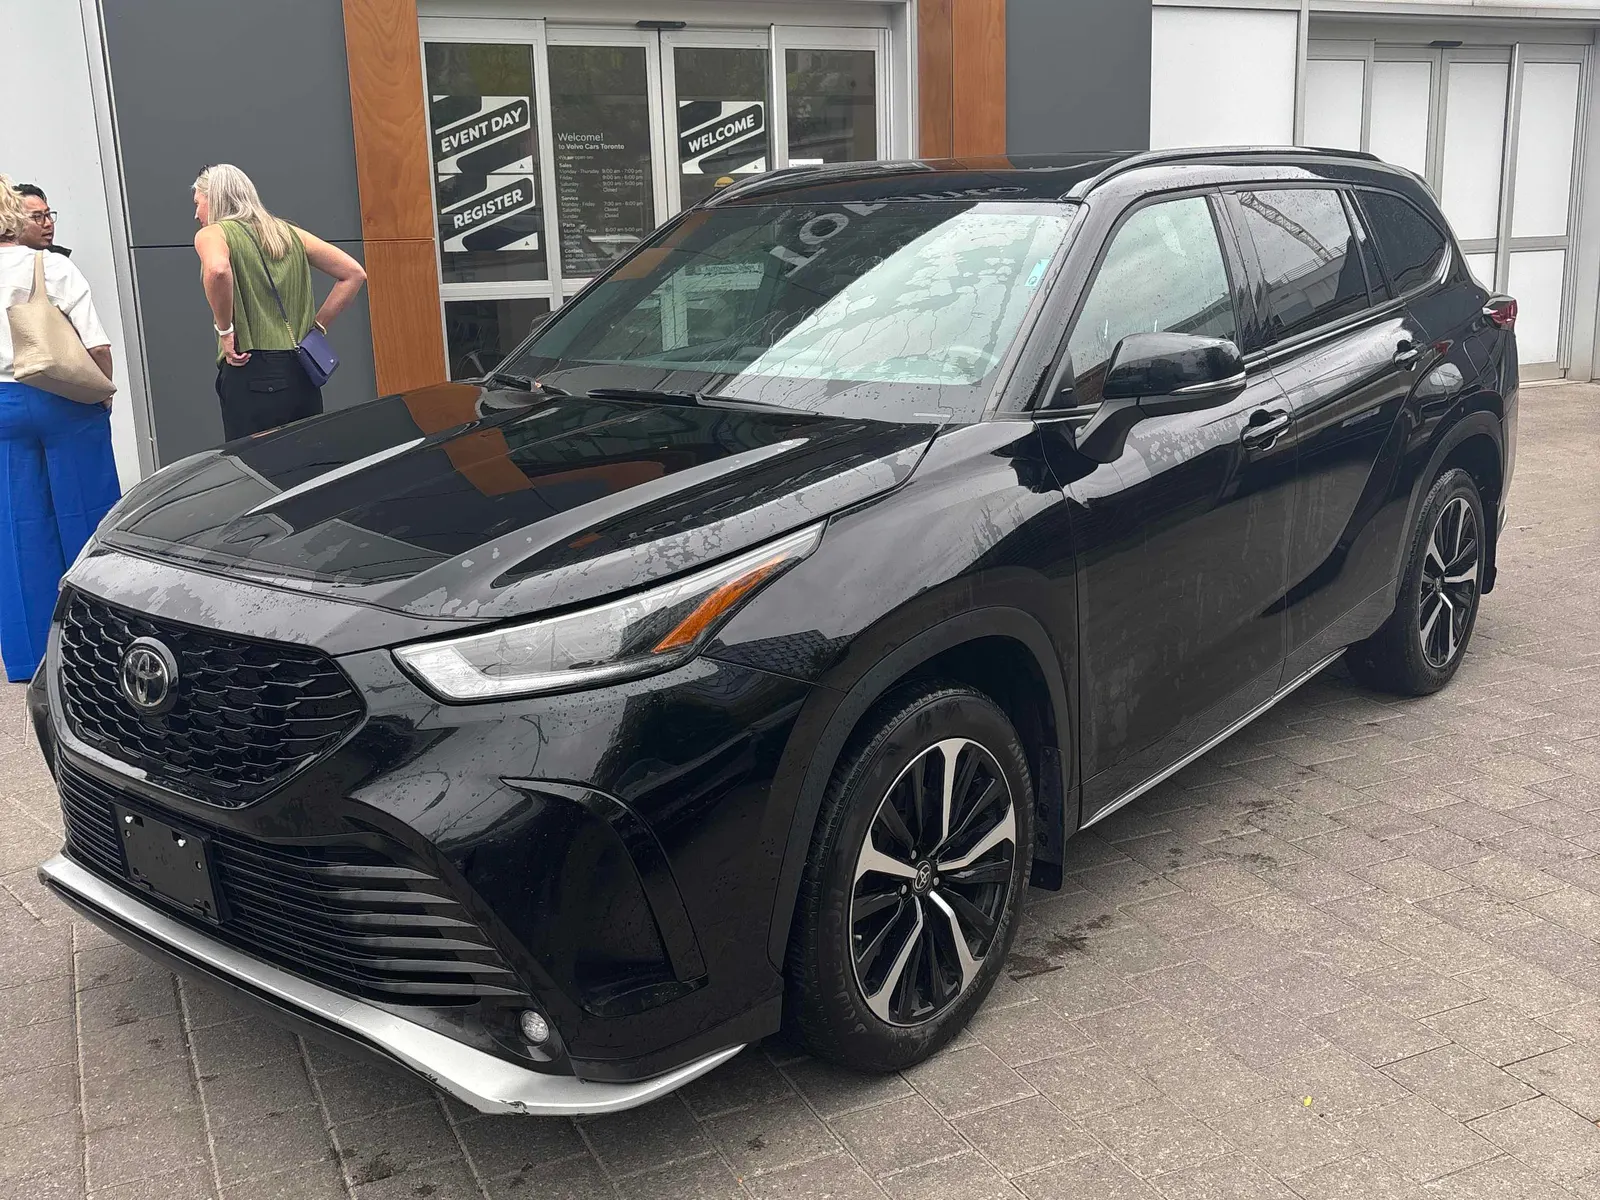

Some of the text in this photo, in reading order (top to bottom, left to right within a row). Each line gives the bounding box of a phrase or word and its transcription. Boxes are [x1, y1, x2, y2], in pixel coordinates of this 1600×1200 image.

[441, 107, 522, 152] EVENT DAY
[557, 132, 604, 142] Welcome!
[688, 113, 755, 153] WELCOME
[453, 188, 523, 229] REGISTER
